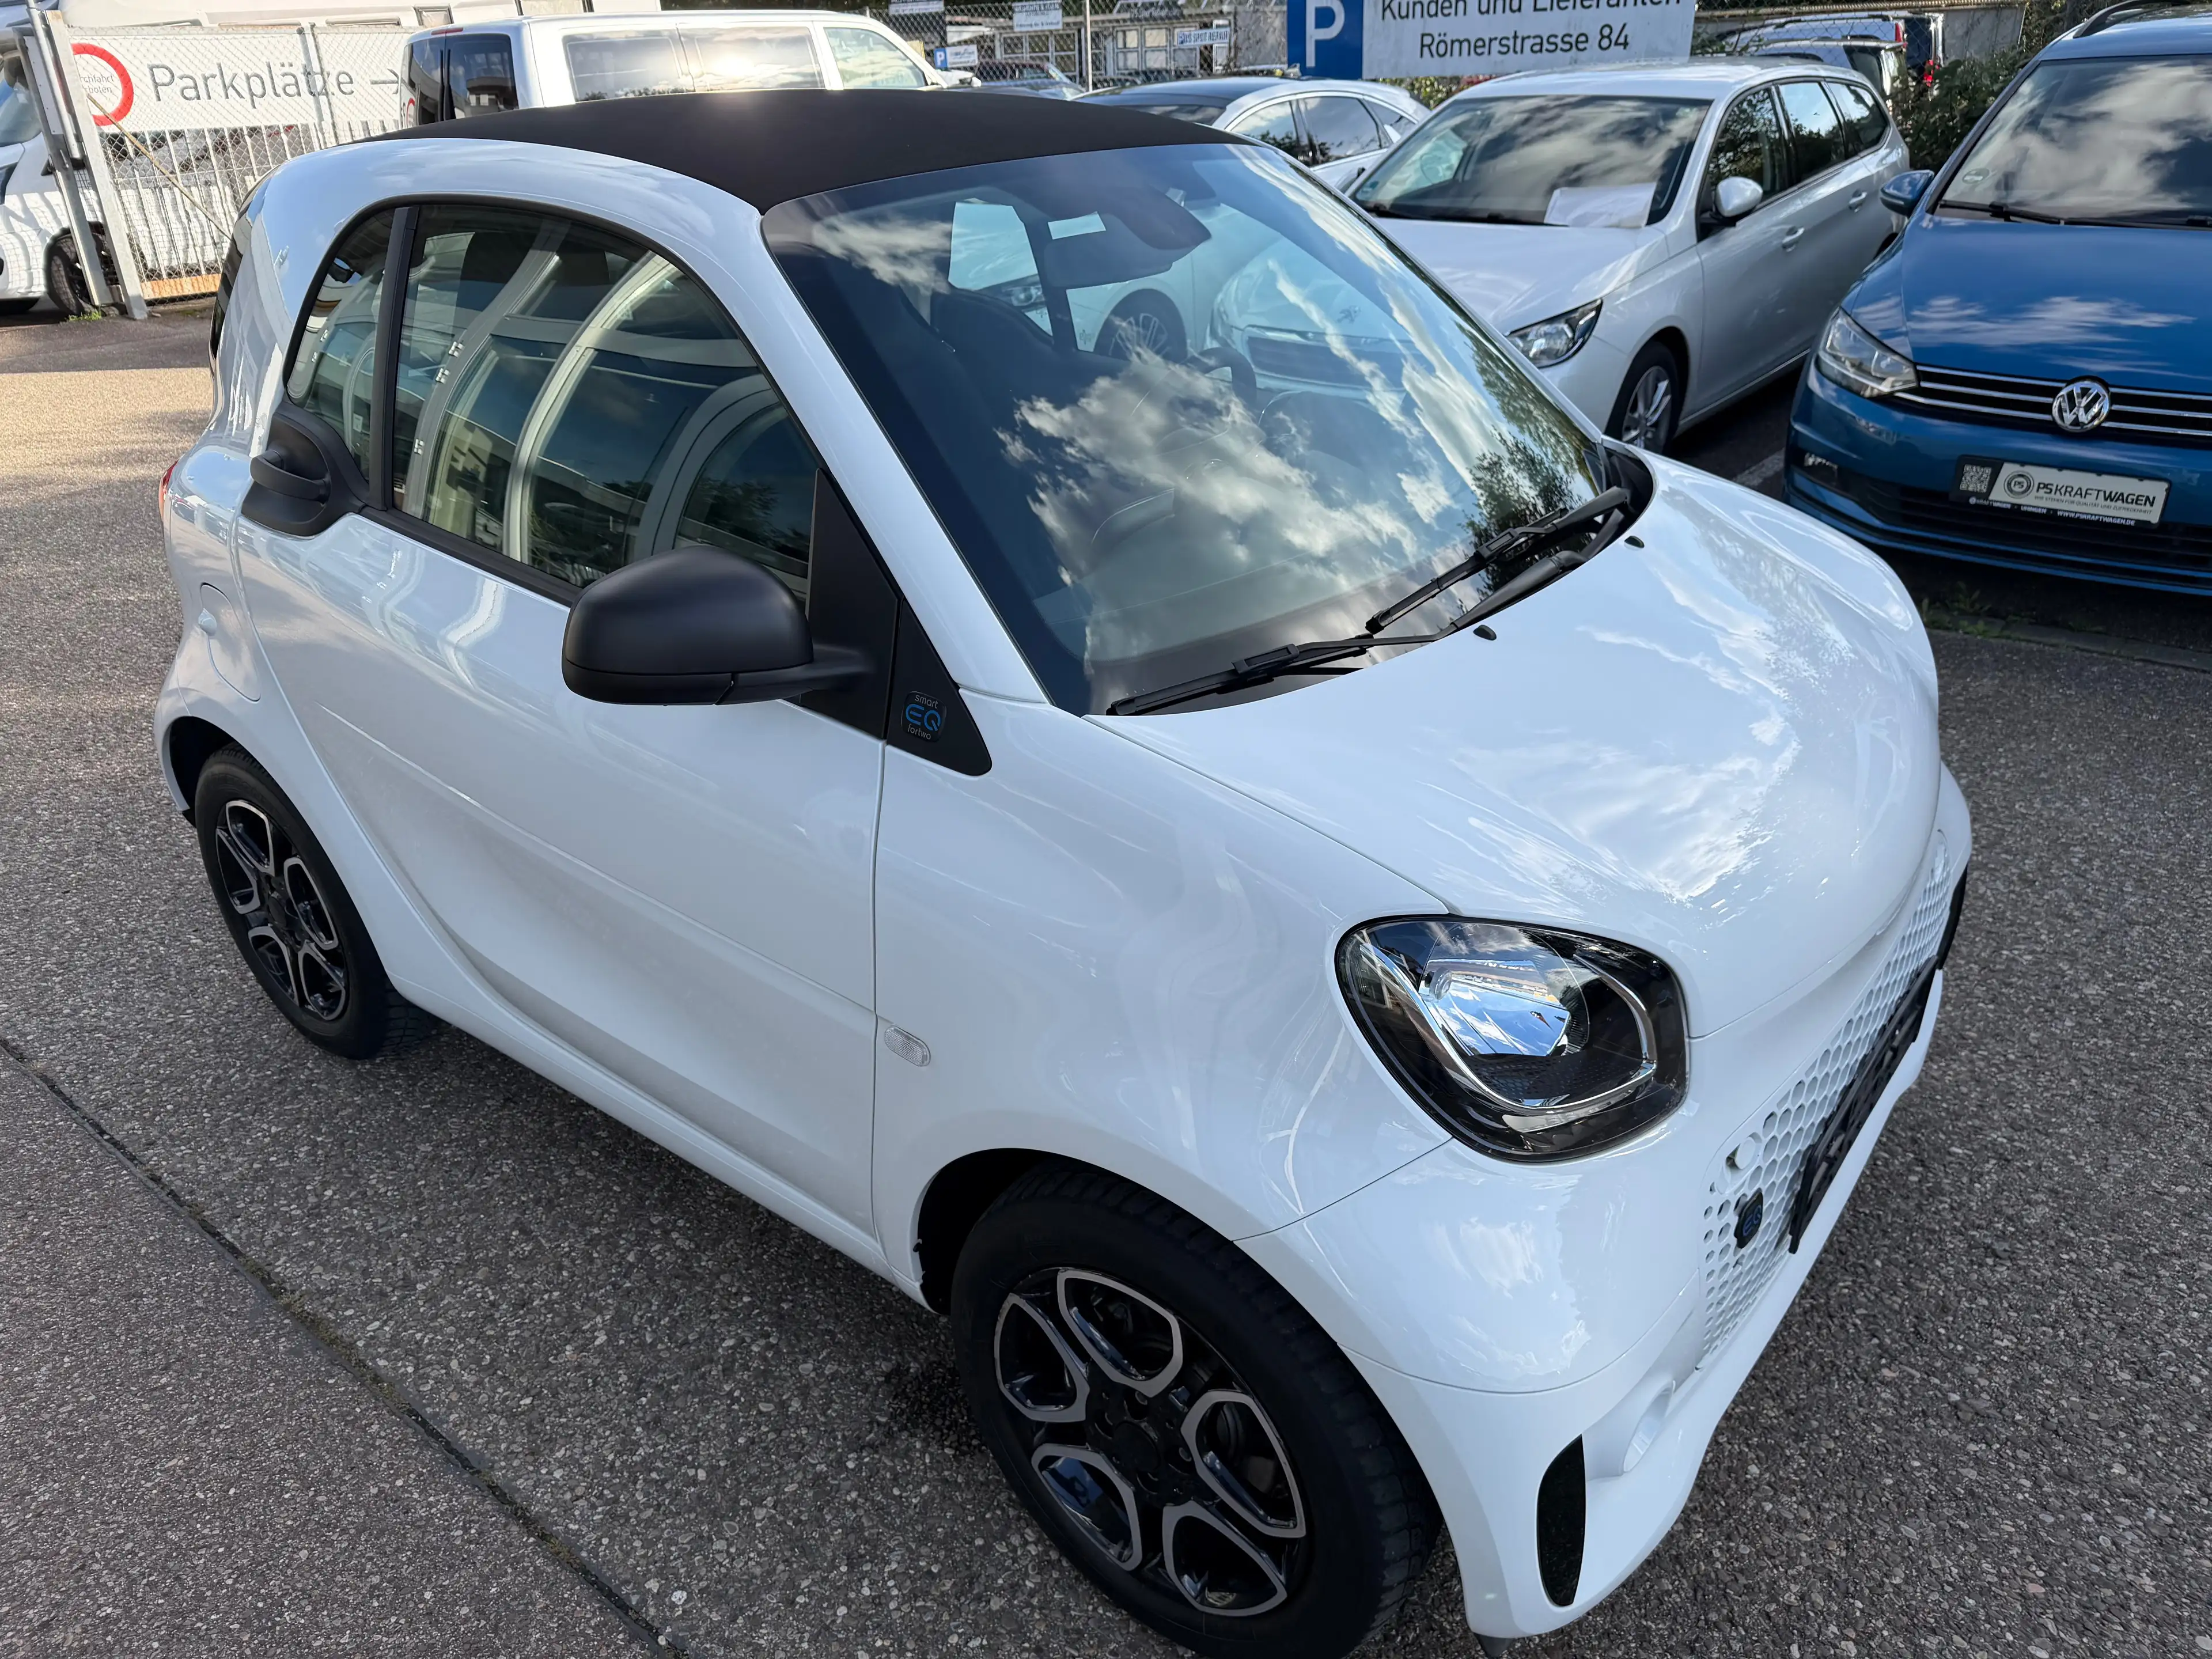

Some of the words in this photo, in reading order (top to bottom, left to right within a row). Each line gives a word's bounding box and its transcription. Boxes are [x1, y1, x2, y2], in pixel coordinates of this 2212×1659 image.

[1305, 0, 1344, 67] P
[1419, 30, 1589, 59] Römerstrasse
[1597, 22, 1629, 51] 84
[146, 60, 354, 109] Parkplätze
[2036, 482, 2156, 508] PSKRAFTWAGEN
[914, 694, 939, 709] smart
[905, 703, 941, 732] EQ
[907, 723, 931, 740] fortwo
